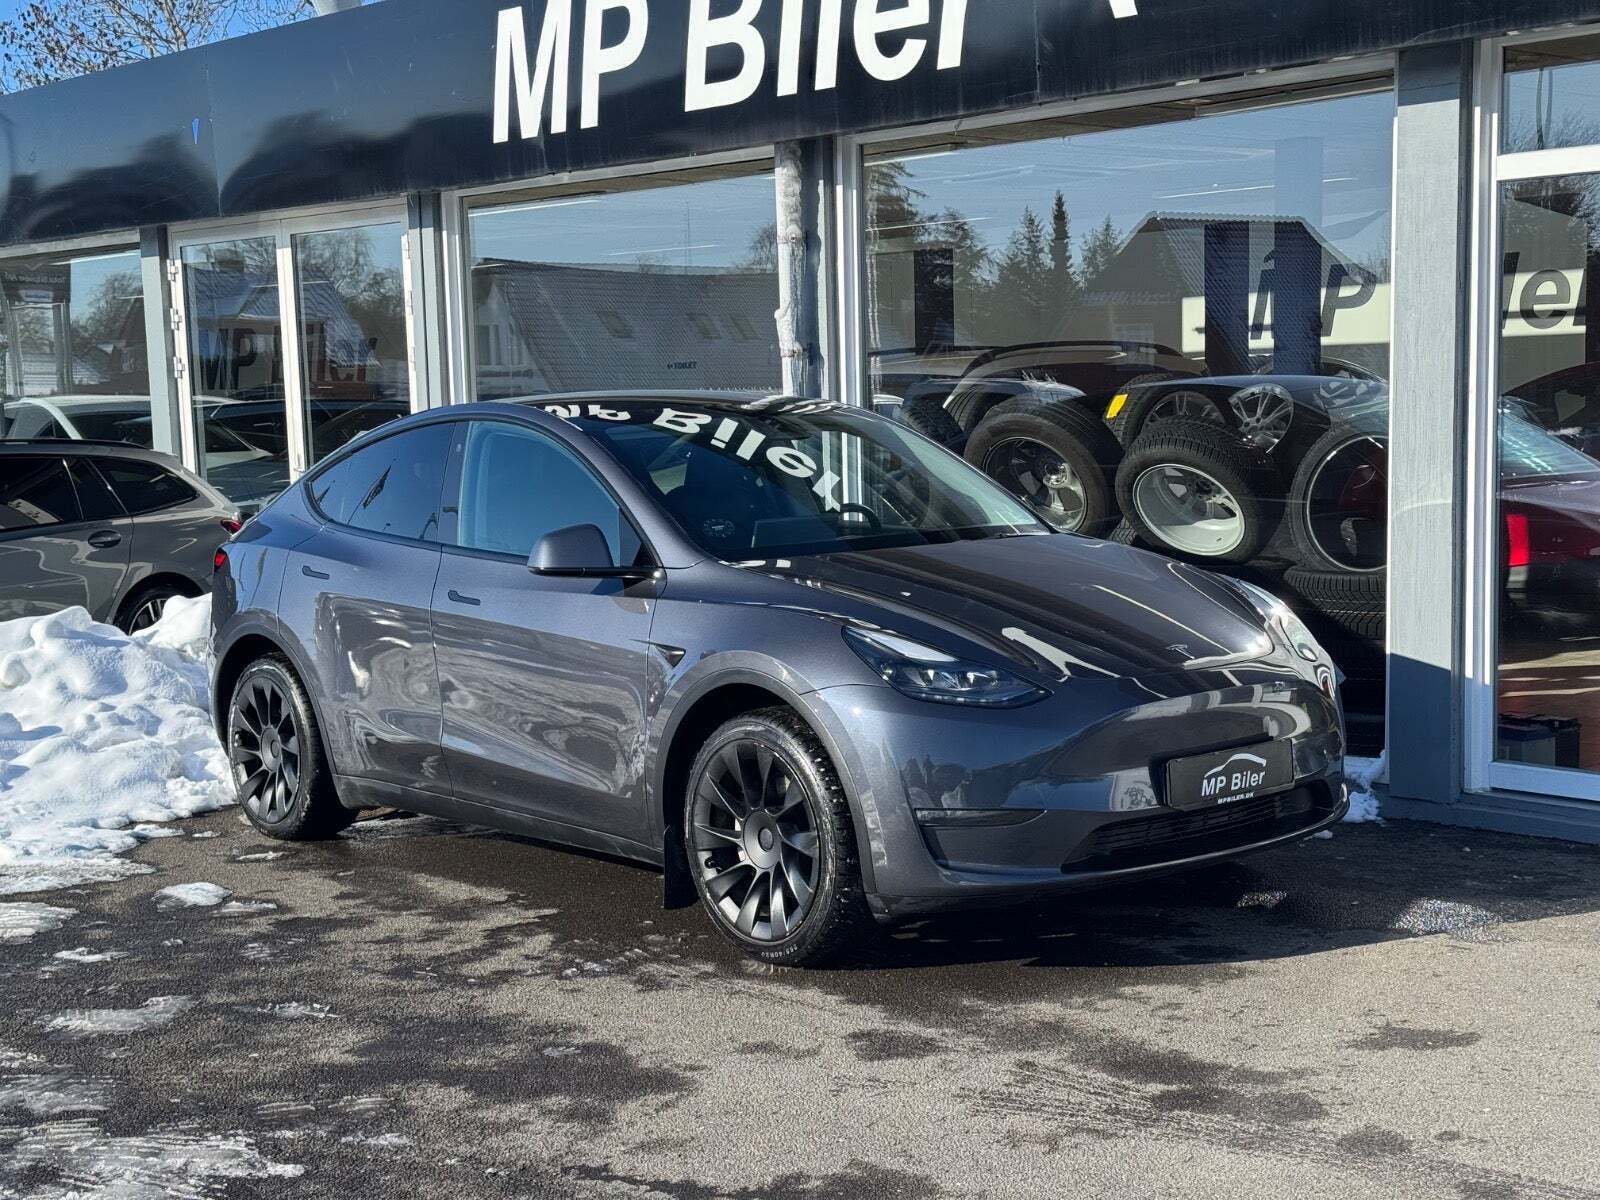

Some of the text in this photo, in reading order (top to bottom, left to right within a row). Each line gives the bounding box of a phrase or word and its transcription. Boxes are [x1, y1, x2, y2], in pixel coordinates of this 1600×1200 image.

[492, 0, 648, 144] MP
[1201, 770, 1265, 797] MP Biler
